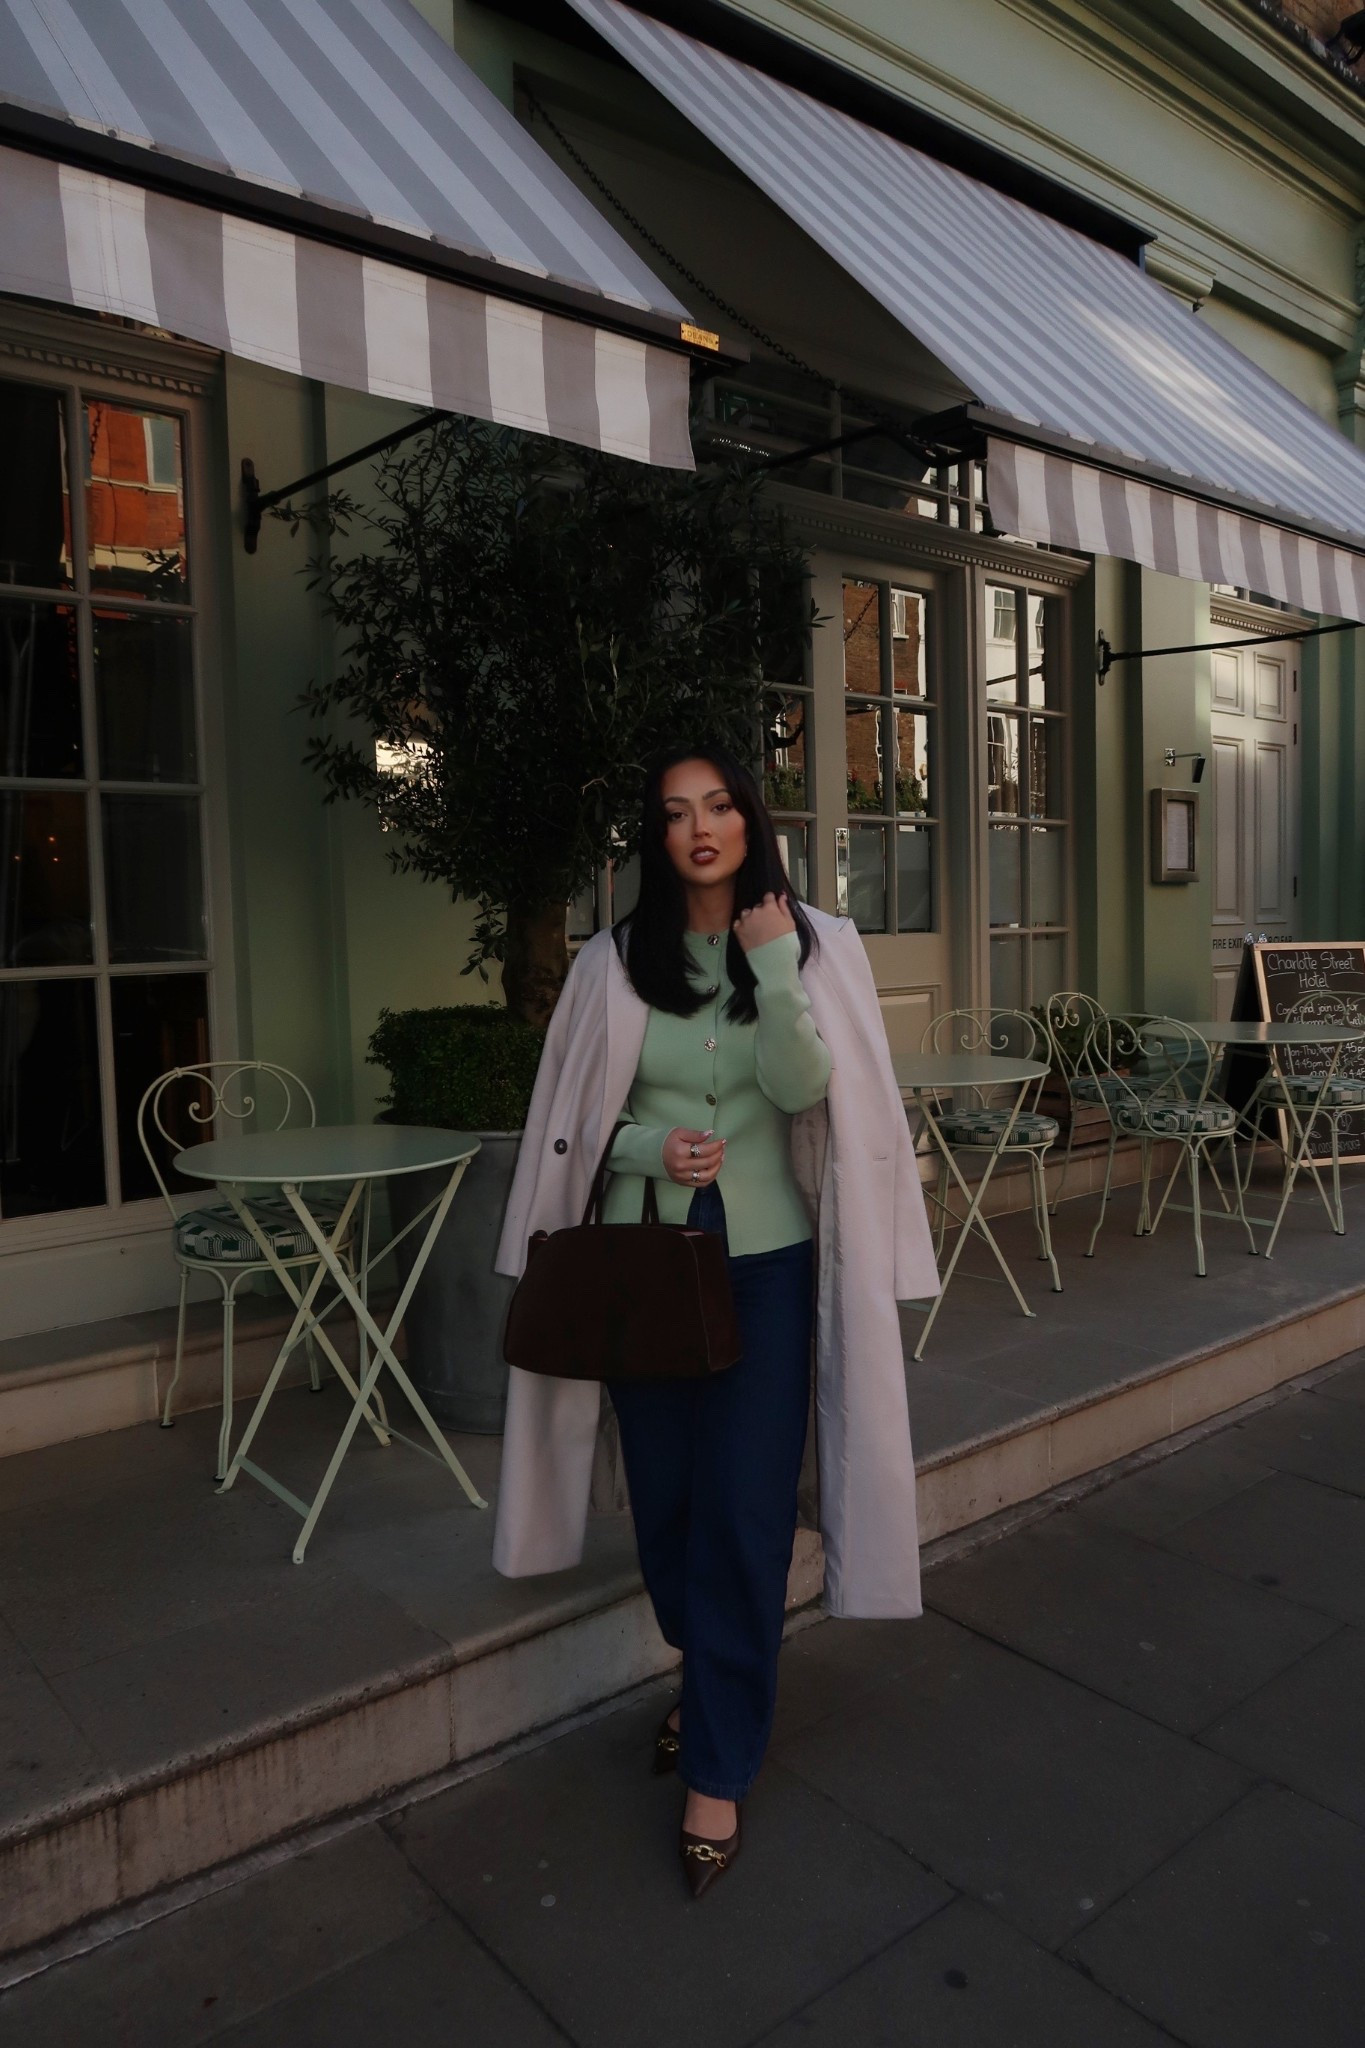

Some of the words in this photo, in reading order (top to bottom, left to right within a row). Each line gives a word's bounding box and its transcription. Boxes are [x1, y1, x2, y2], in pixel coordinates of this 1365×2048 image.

[1213, 939, 1226, 949] FIRE
[1228, 938, 1243, 949] EXIT
[1267, 951, 1317, 971] Charlotte
[1320, 950, 1355, 971] Street
[1299, 971, 1330, 988] Hotel
[1317, 1003, 1333, 1016] join
[1325, 1057, 1342, 1067] ad
